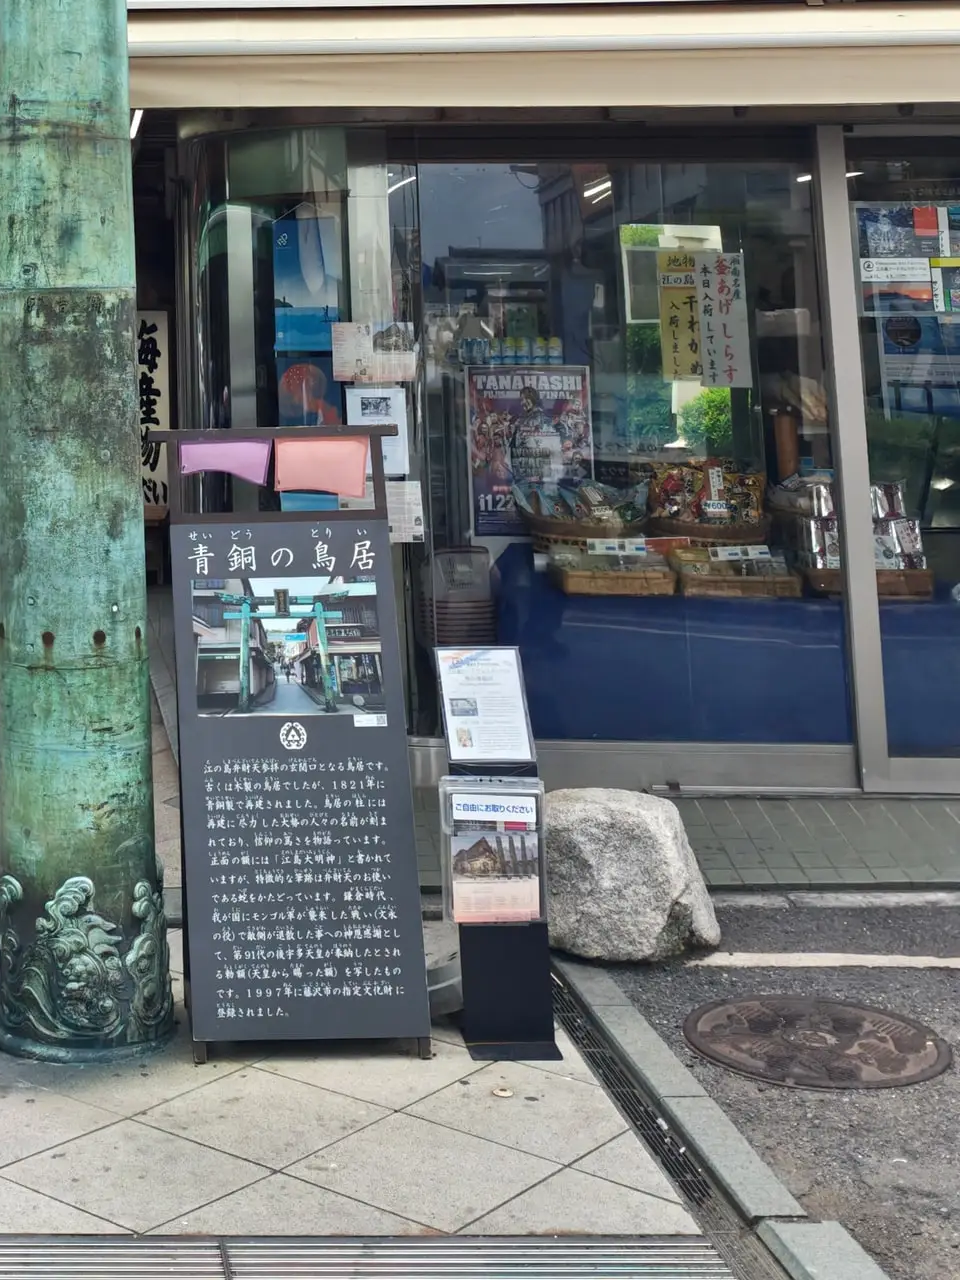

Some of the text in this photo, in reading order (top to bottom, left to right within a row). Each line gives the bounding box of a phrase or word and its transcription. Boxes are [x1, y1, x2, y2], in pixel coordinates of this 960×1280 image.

[699, 264, 719, 384] 本日入荷しています
[472, 375, 583, 391] TANAHASHI
[539, 391, 574, 400] FINAL
[311, 527, 332, 539] とり
[357, 528, 367, 536] い
[187, 540, 376, 576] 青銅の鳥居
[455, 803, 534, 814] ご自由にお取りください
[217, 1007, 289, 1018] 登録されました。
